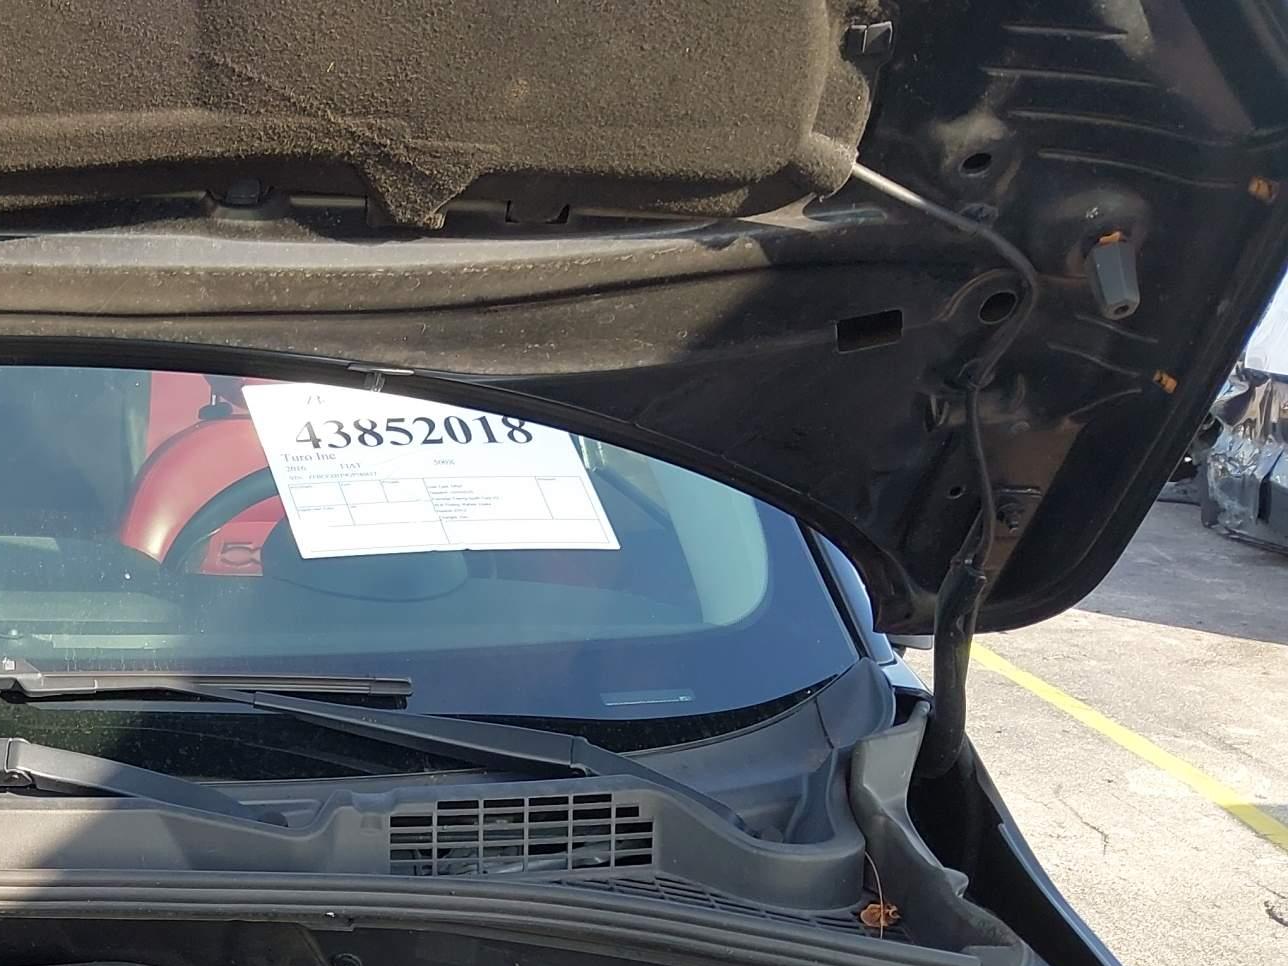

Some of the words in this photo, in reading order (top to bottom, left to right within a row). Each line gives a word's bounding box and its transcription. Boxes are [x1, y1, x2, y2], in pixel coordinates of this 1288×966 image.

[294, 414, 535, 450] 43852018
[280, 452, 313, 463] Turo
[316, 451, 337, 462] Inc
